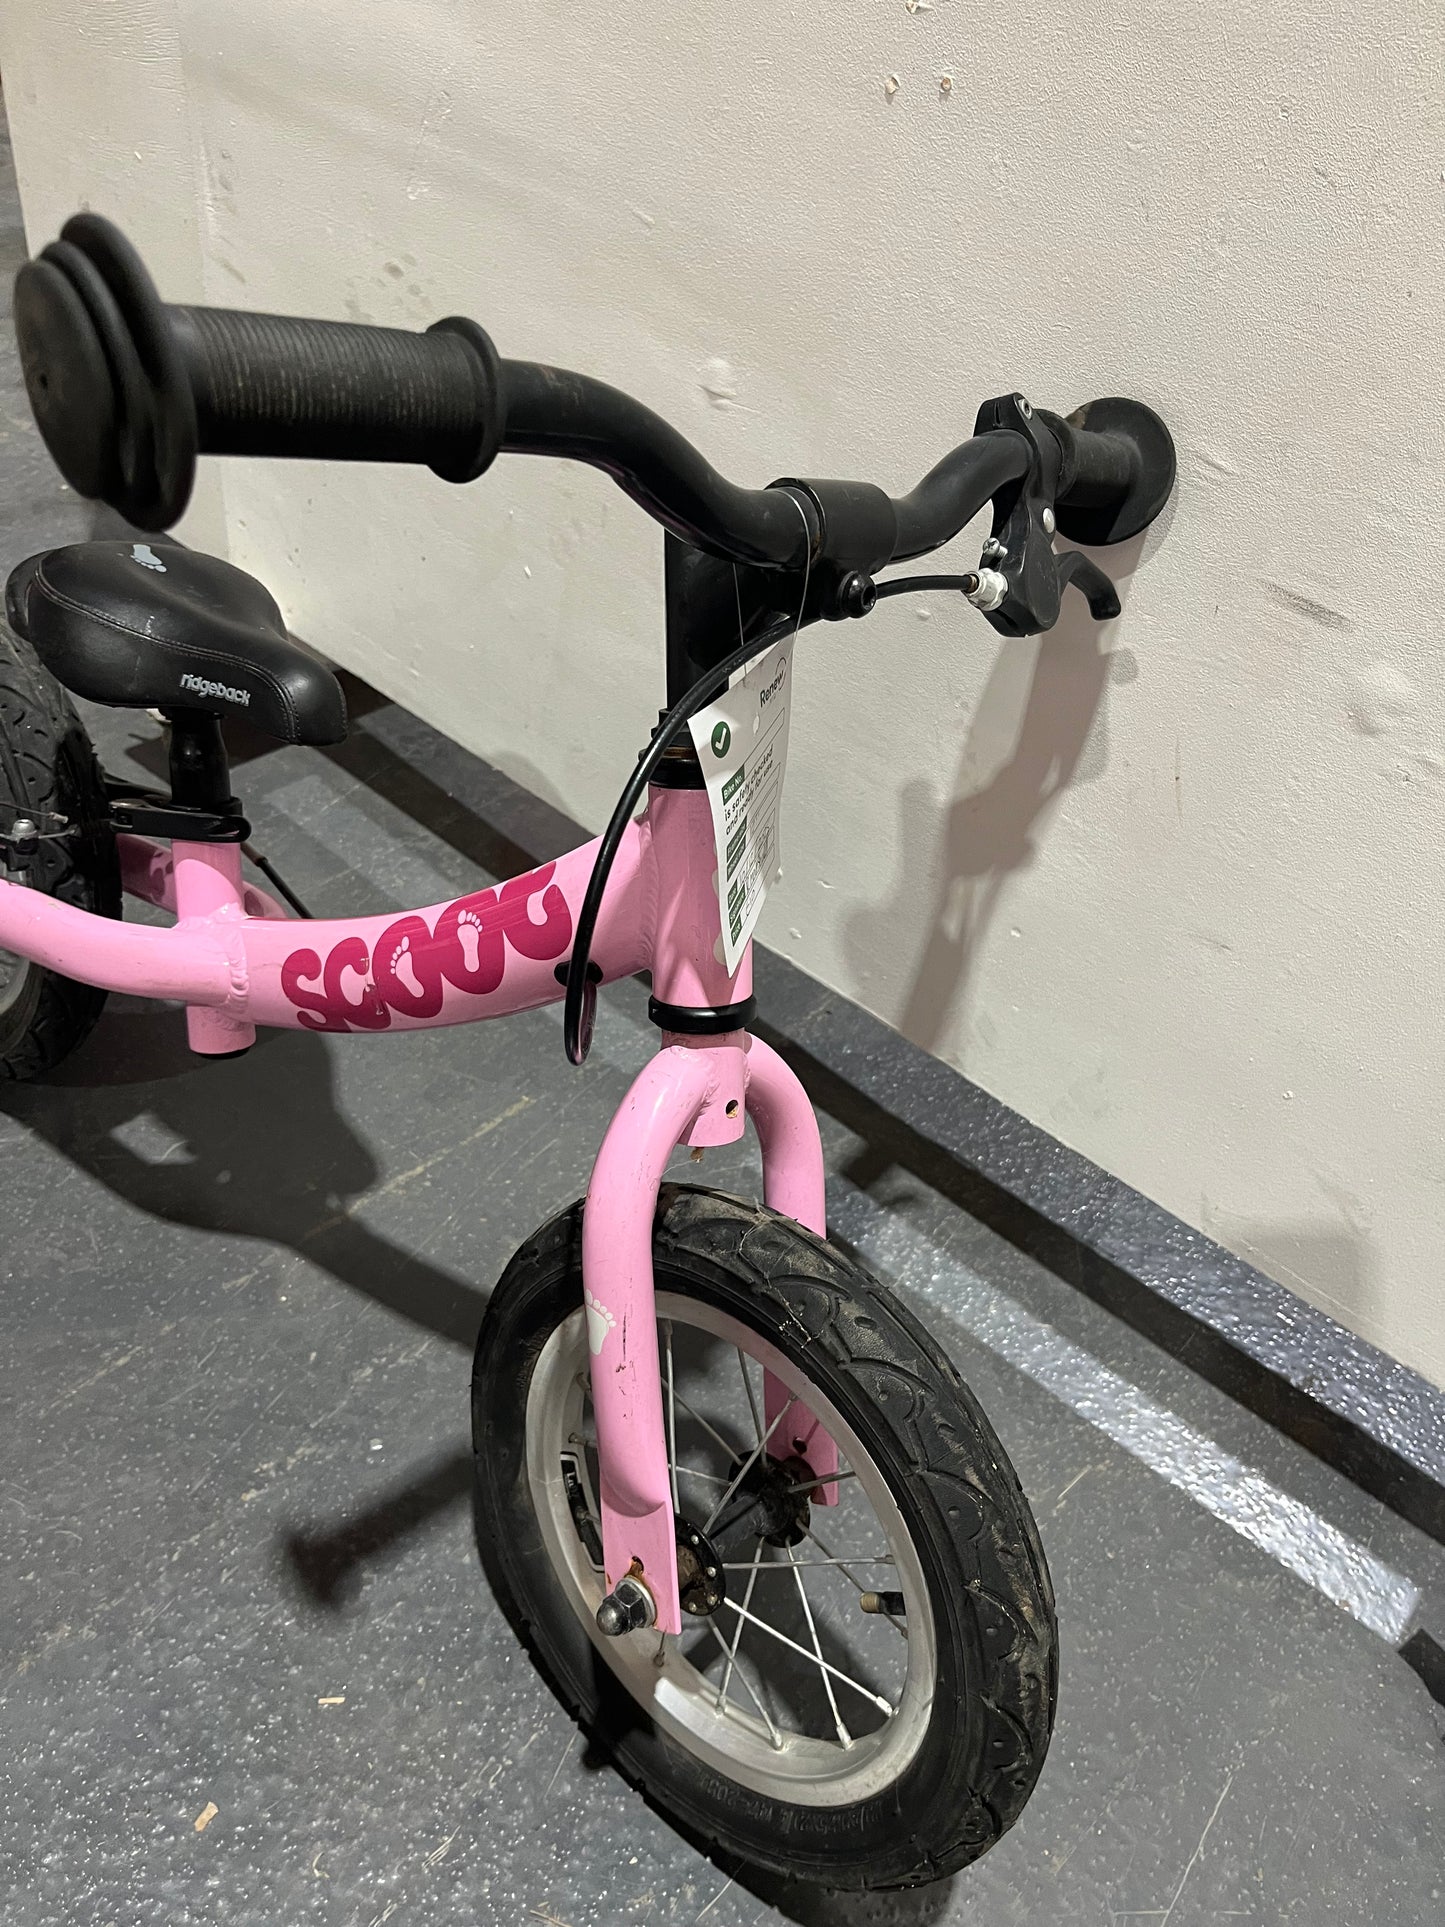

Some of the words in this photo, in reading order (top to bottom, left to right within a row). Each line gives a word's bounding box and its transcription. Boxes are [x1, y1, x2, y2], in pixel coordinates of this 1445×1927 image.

[180, 673, 251, 707] ridgeback
[760, 669, 784, 708] Renew
[723, 783, 735, 800] Bike
[724, 808, 731, 821] is
[732, 781, 750, 812] safety
[750, 743, 773, 784] checked
[725, 809, 738, 835] and
[738, 787, 754, 817] ready
